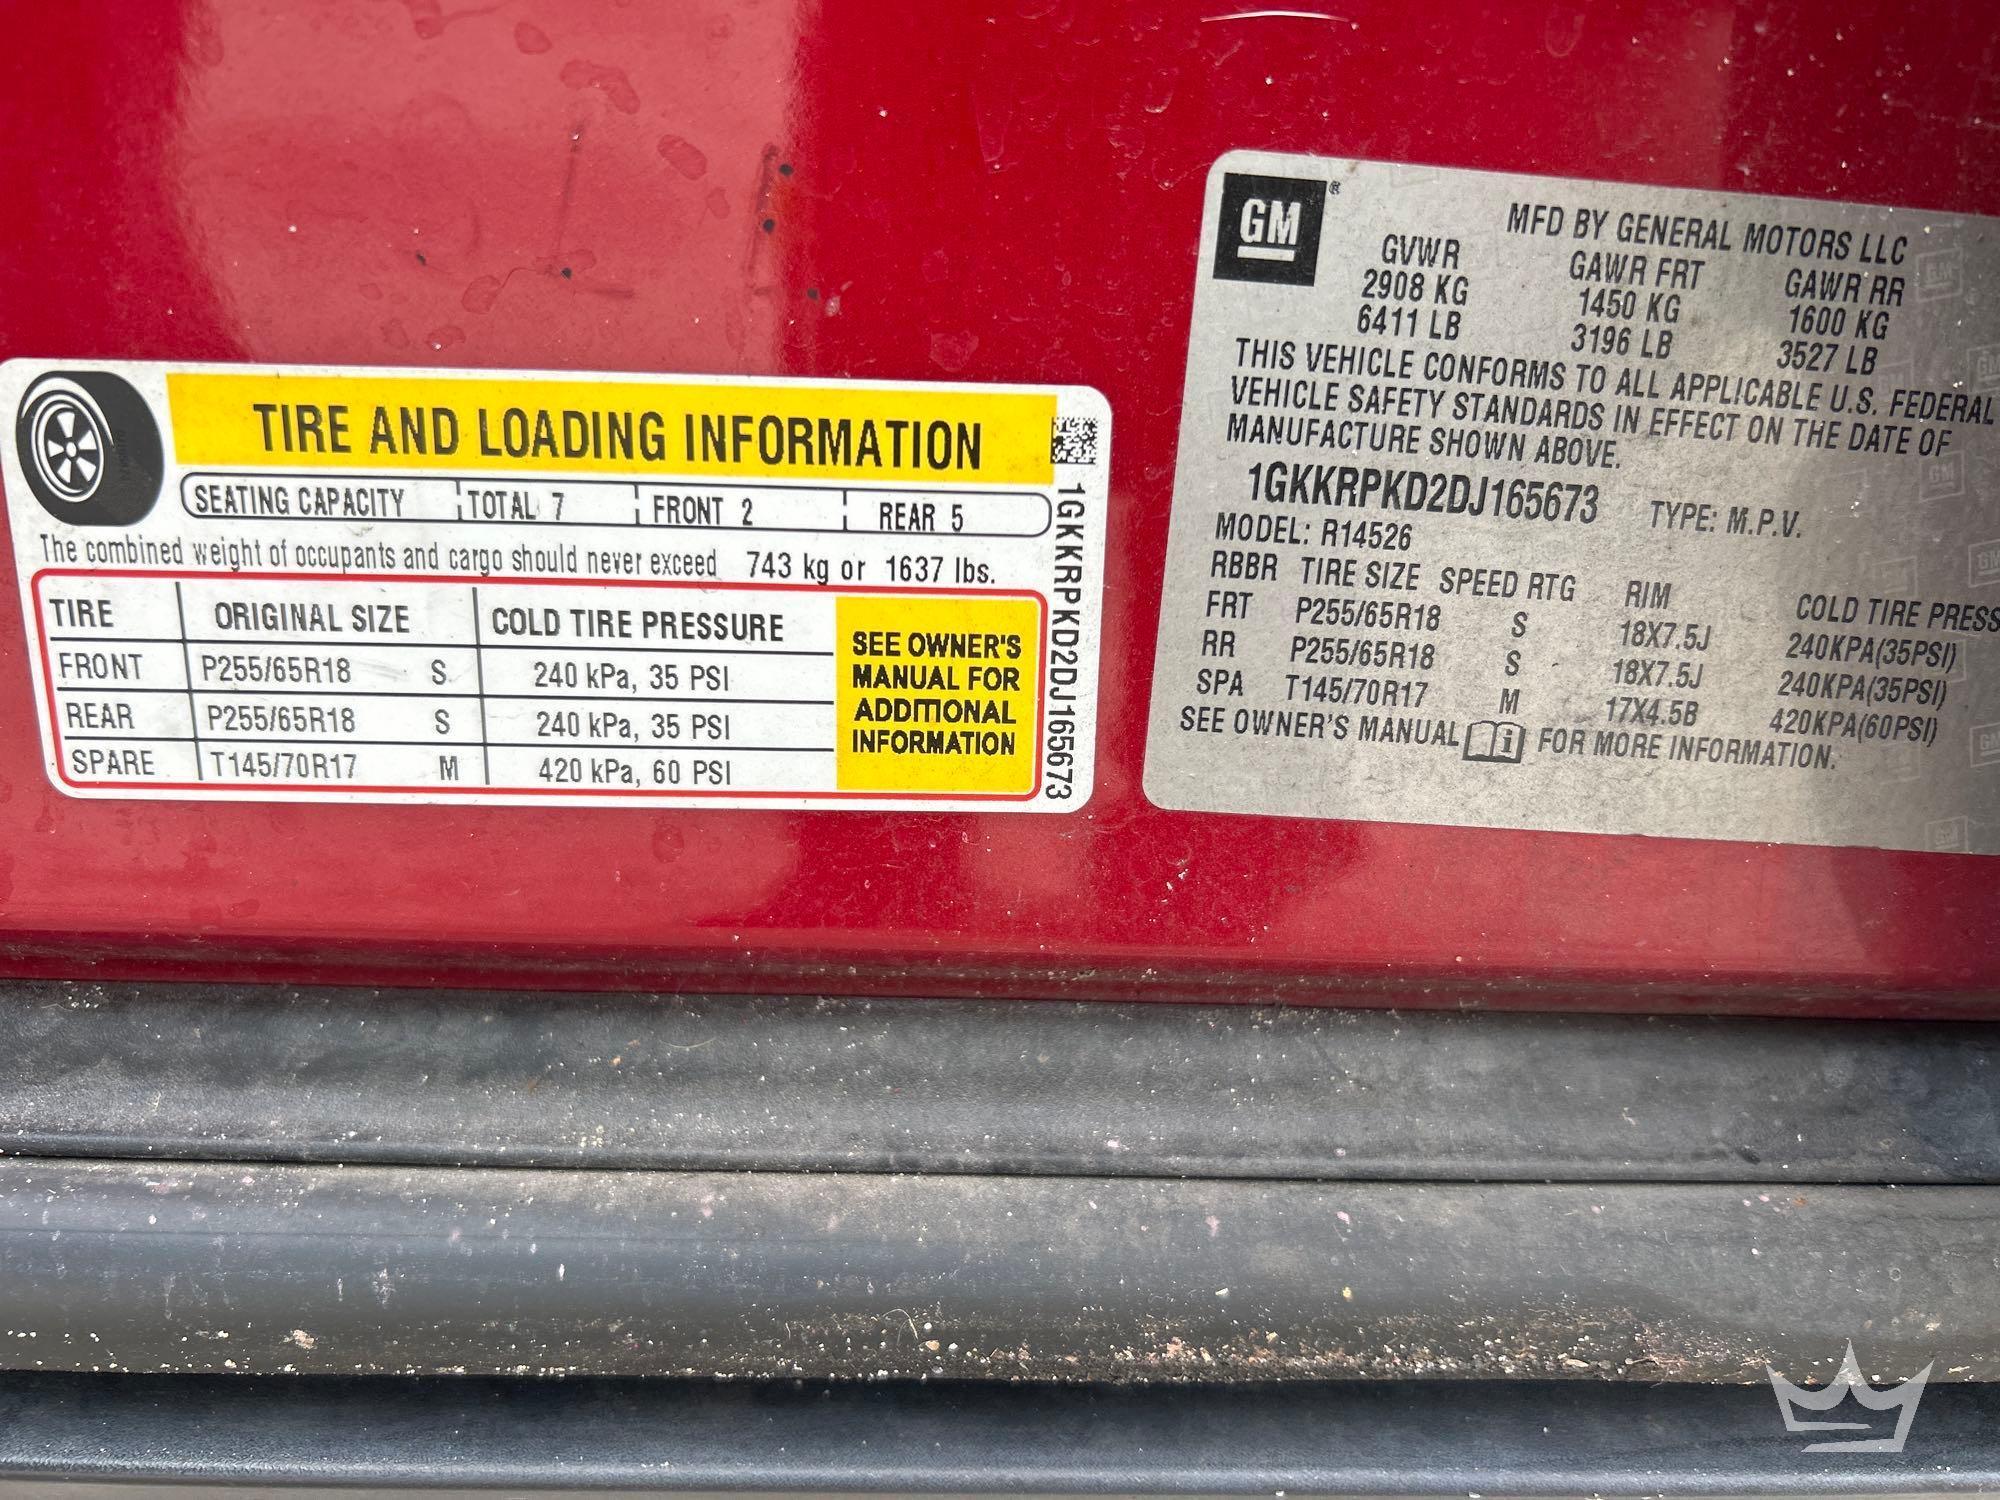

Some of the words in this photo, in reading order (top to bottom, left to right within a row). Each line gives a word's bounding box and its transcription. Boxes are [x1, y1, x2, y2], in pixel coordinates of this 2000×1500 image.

[1240, 197, 1301, 245] GM
[1507, 203, 1564, 236] MFD
[1573, 208, 1609, 240] BY
[1617, 212, 1731, 251] GENERAL
[1743, 223, 1852, 260] MOTORS
[1859, 233, 1907, 265] LLC
[1382, 234, 1460, 269] GVWR
[1362, 269, 1425, 302] 2908
[1434, 274, 1468, 306] KG
[1569, 250, 1647, 285] GAWR
[1655, 258, 1705, 290] FRT
[1785, 268, 1861, 303] GAWR
[1869, 275, 1905, 306] RR
[1357, 304, 1417, 337] 6411
[1429, 310, 1461, 340] LB
[1580, 287, 1636, 320] 1450
[1646, 293, 1681, 323] KG
[1790, 304, 1846, 336] 1600
[1855, 309, 1889, 340] KG
[1571, 323, 1631, 355] 3196
[1641, 329, 1673, 359] LB
[1777, 340, 1839, 372] 3527
[1845, 345, 1878, 375] LB
[1236, 338, 1295, 370] THIS
[1306, 343, 1414, 379] VEHICLE
[1424, 352, 1566, 390] CONFORMS
[1577, 364, 1606, 394] TO
[1615, 368, 1659, 399] ALL
[1669, 372, 1822, 412] APPLICABLE
[1830, 384, 1877, 415] U.S.
[1889, 389, 1993, 425] FEDERAL
[1232, 376, 1339, 411] VEHICLE
[1348, 384, 1446, 419] SAFETY
[1452, 392, 1605, 431] STANDARDS
[1613, 405, 1640, 434] IN
[1649, 407, 1741, 441] EFFECT
[1748, 415, 1784, 445] ON
[1794, 418, 1842, 449] THE
[1848, 423, 1912, 454] DATE
[1919, 428, 1952, 457] OF
[253, 404, 351, 453] TIRE
[370, 407, 459, 455] AND
[479, 408, 665, 461] LOADING
[686, 414, 980, 470] INFORMATION
[1227, 413, 1421, 454] MANUFACTURE
[1429, 427, 1526, 461] SHOWN
[1534, 435, 1620, 469] ABOVE.
[195, 485, 289, 514] SEATING
[298, 487, 404, 517] CAPACITY
[468, 490, 536, 520] TOTAL
[552, 492, 564, 520] 7
[1248, 461, 1599, 524] 1GKKRPKD2DJ165673
[654, 495, 723, 525] FRONT
[742, 498, 752, 526] 2
[880, 502, 935, 531] REAR
[951, 504, 965, 532] 5
[1651, 500, 1717, 532] TYPE:
[1726, 506, 1801, 538] M.P.V.
[1216, 512, 1310, 545] MODEL:
[1321, 519, 1412, 551] R14526
[40, 534, 77, 562] The
[86, 535, 183, 565] combined
[192, 538, 262, 572] weight
[270, 539, 287, 567] of
[295, 542, 396, 574] occupants
[404, 542, 439, 570] and
[449, 547, 503, 577] cargo
[512, 544, 577, 573] should
[588, 552, 641, 574] never
[651, 549, 716, 576] exceed
[747, 551, 791, 578] 743
[803, 552, 830, 586] kg
[841, 556, 865, 580] or
[886, 556, 943, 582] 1637
[956, 557, 994, 583] lbs.
[1211, 550, 1277, 581] RBBR
[1302, 557, 1357, 587] TIRE
[1365, 561, 1420, 590] SIZE
[1439, 567, 1518, 598] SPEED
[1527, 573, 1576, 601] RTG
[49, 599, 113, 627] TIRE
[1625, 580, 1672, 611] RIM
[1797, 594, 1859, 623] COLD
[1868, 598, 1922, 627] TIRE
[215, 602, 342, 631] ORIGINAL
[352, 605, 409, 633] SIZE
[492, 608, 560, 636] COLD
[570, 609, 631, 638] TIRE
[643, 611, 783, 641] PRESSURE
[1206, 590, 1253, 619] FRT
[1296, 597, 1441, 631] P255/65R18
[1511, 612, 1529, 638] S
[853, 631, 900, 656] SEE
[908, 633, 1021, 659] OWNER'S
[1044, 482, 1087, 801] 1GKKRPKD2DJ165673
[1202, 630, 1235, 657] RR
[1290, 636, 1435, 670] P255/65R18
[1505, 650, 1521, 676] S
[1620, 620, 1712, 652] 18X7.5J
[59, 653, 142, 679] FRONT
[202, 655, 350, 683] P255/65R18
[431, 659, 446, 685] S
[534, 662, 577, 688] 240
[587, 663, 636, 693] kPa,
[650, 664, 678, 689] 35
[691, 665, 728, 691] PSI
[853, 664, 959, 690] MANUAL
[969, 666, 1020, 691] FOR
[1613, 659, 1703, 689] 18X7.5J
[1197, 669, 1243, 696] SPA
[1286, 674, 1428, 707] T145/70R17
[1499, 688, 1520, 714] M
[66, 703, 135, 729] REAR
[208, 705, 355, 732] P255/65R18
[435, 709, 450, 734] S
[537, 711, 579, 737] 240
[589, 712, 638, 742] kPa,
[652, 713, 680, 738] 35
[692, 714, 729, 739] PSI
[854, 698, 1016, 724] ADDITIONAL
[1180, 706, 1225, 733] SEE
[1234, 709, 1349, 741] OWNER'S
[1358, 716, 1459, 746] MANUAL
[1606, 700, 1700, 727] 17X4.5B
[853, 729, 1015, 756] INFORMATION
[1537, 727, 1584, 755] FOR
[1593, 729, 1663, 759] MORE
[1669, 735, 1835, 769] INFORMATION.
[72, 749, 154, 775] SPARE
[210, 752, 356, 778] T145/70R17
[439, 756, 458, 780] M
[539, 758, 582, 782] 420
[591, 759, 640, 787] kPa,
[654, 760, 680, 784] 60
[694, 760, 730, 785] PSI
